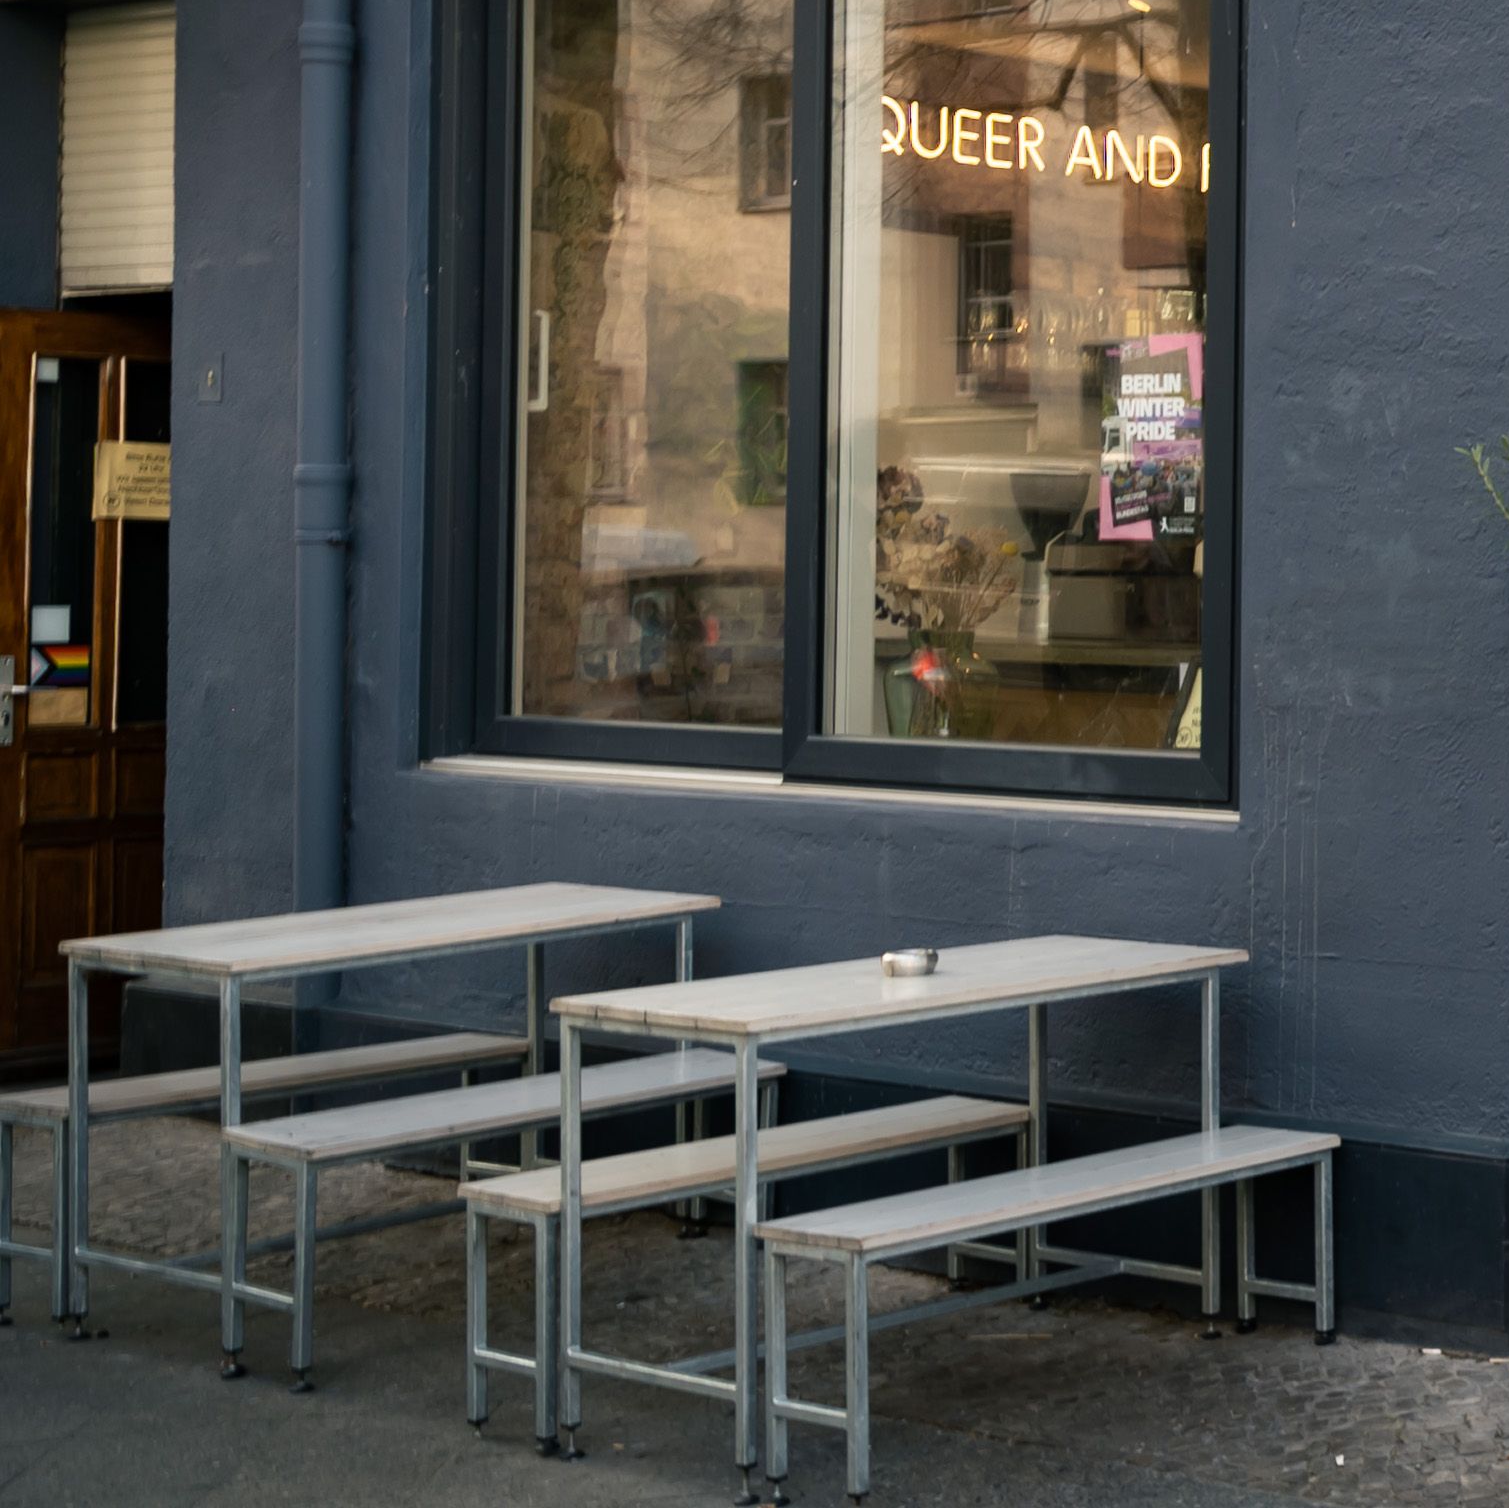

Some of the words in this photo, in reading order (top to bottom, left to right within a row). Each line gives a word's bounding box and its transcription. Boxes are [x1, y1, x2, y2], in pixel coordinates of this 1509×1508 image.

[881, 94, 1045, 172] QUEER
[1064, 124, 1182, 189] AND
[1120, 372, 1182, 394] BERLIN
[1116, 396, 1185, 419] WINTER
[1125, 420, 1176, 442] PRIDE
